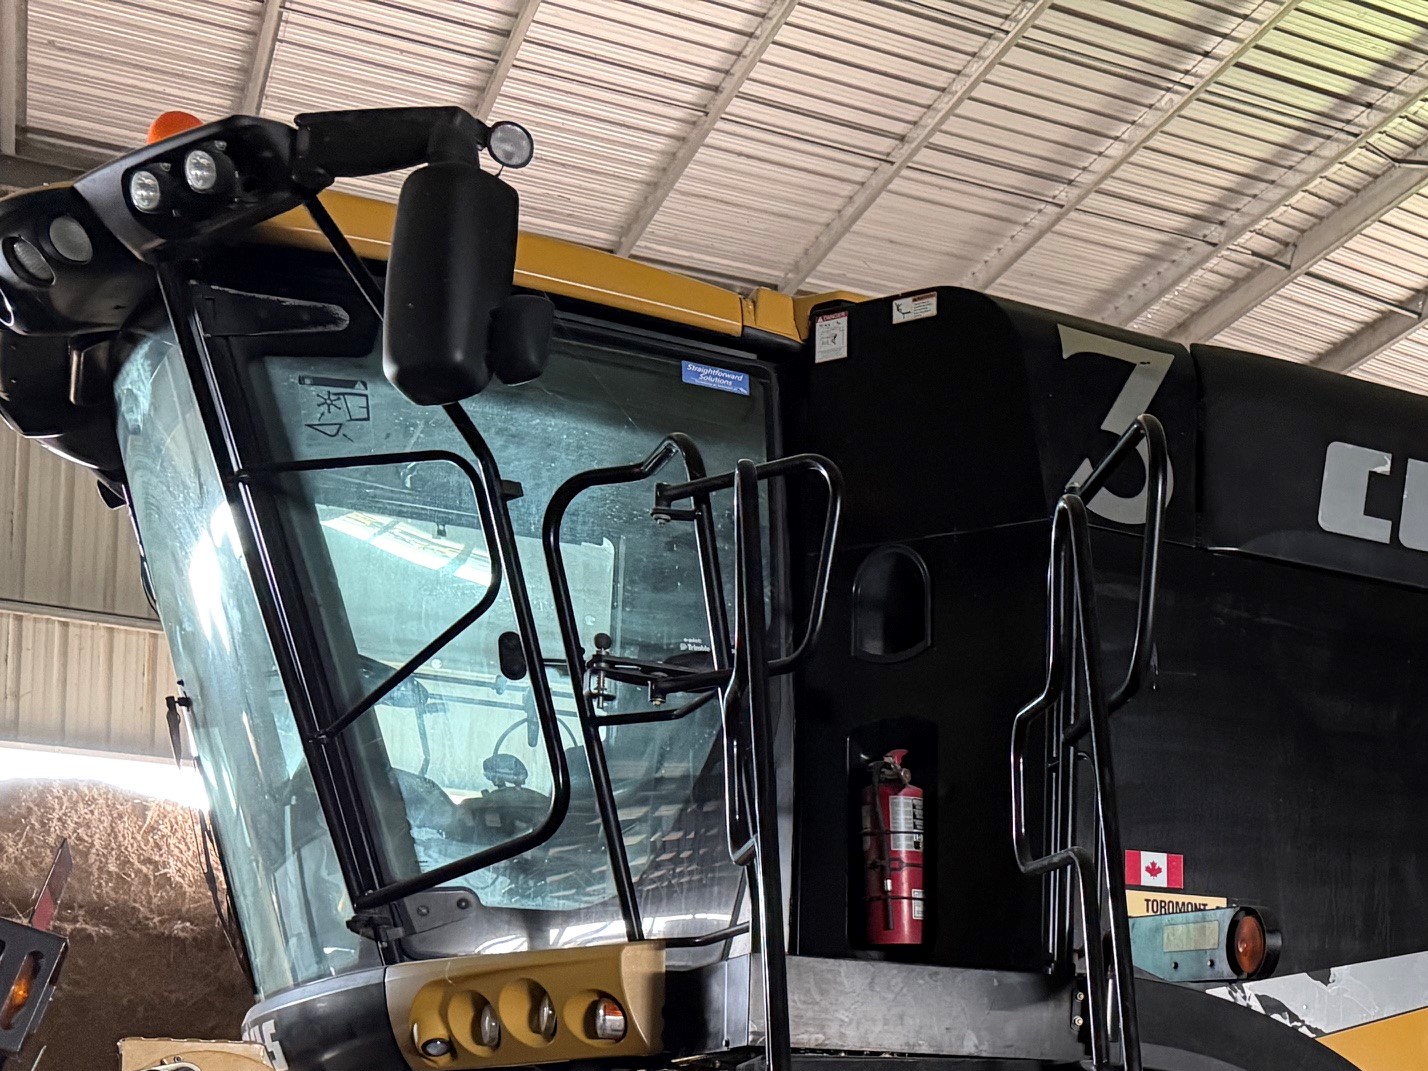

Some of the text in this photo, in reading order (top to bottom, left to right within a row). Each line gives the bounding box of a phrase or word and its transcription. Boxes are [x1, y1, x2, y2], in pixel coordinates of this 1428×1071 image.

[687, 364, 743, 381] Straightforward
[699, 374, 732, 386] Solutions
[1057, 324, 1175, 525] 3
